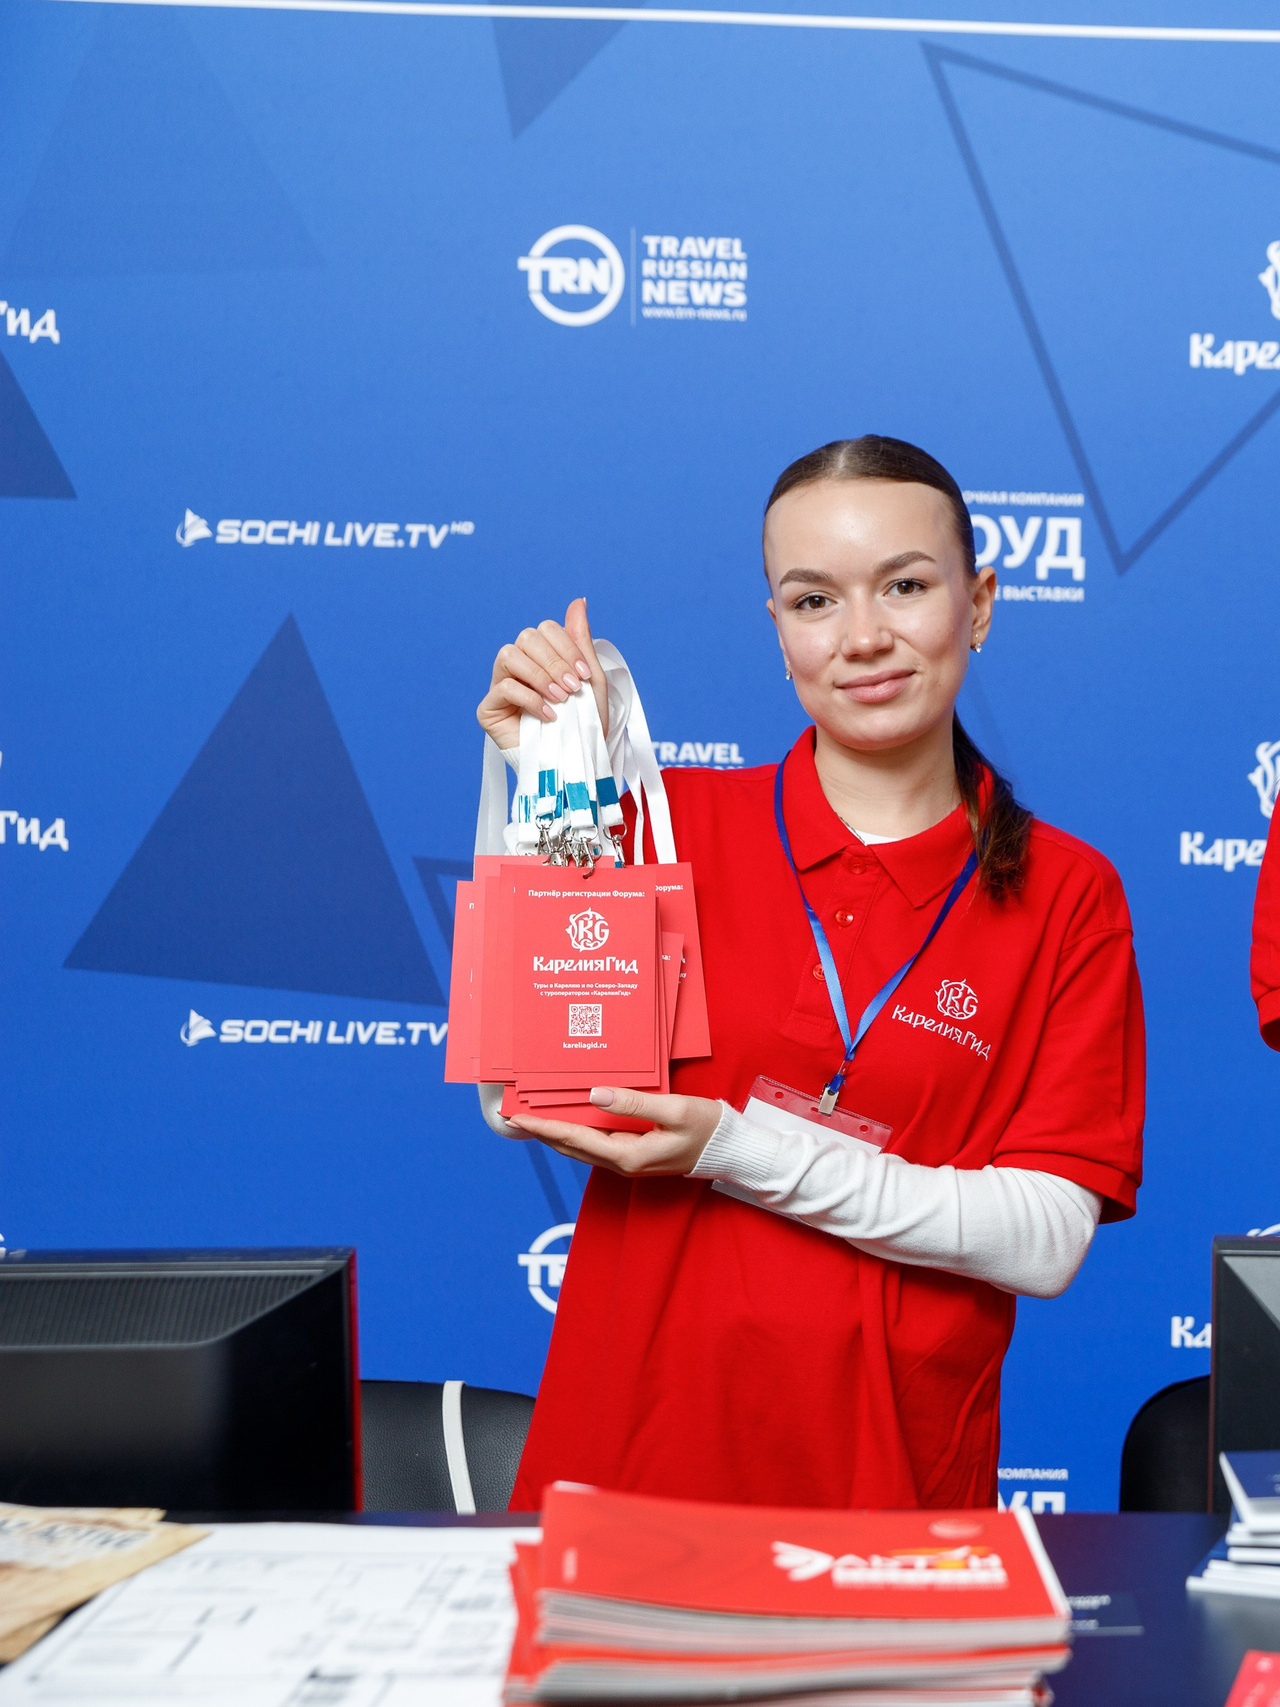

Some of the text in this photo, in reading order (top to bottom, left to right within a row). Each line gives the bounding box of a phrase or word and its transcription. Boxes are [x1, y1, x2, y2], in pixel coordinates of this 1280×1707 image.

[641, 235, 747, 260] TRAVEL
[517, 256, 612, 294] TRN
[641, 259, 748, 280] RUSSIAN
[641, 279, 748, 307] NEWS
[216, 519, 321, 546] SOCHI
[324, 520, 450, 549] LIVE.TV
[969, 513, 1086, 582] ОУД
[528, 889, 645, 898] Партнёр регистрации Форума:
[533, 956, 638, 974] КарелияГид
[219, 1019, 448, 1046] SOCHI LIVE.TV
[892, 1004, 991, 1060] КарелияГид
